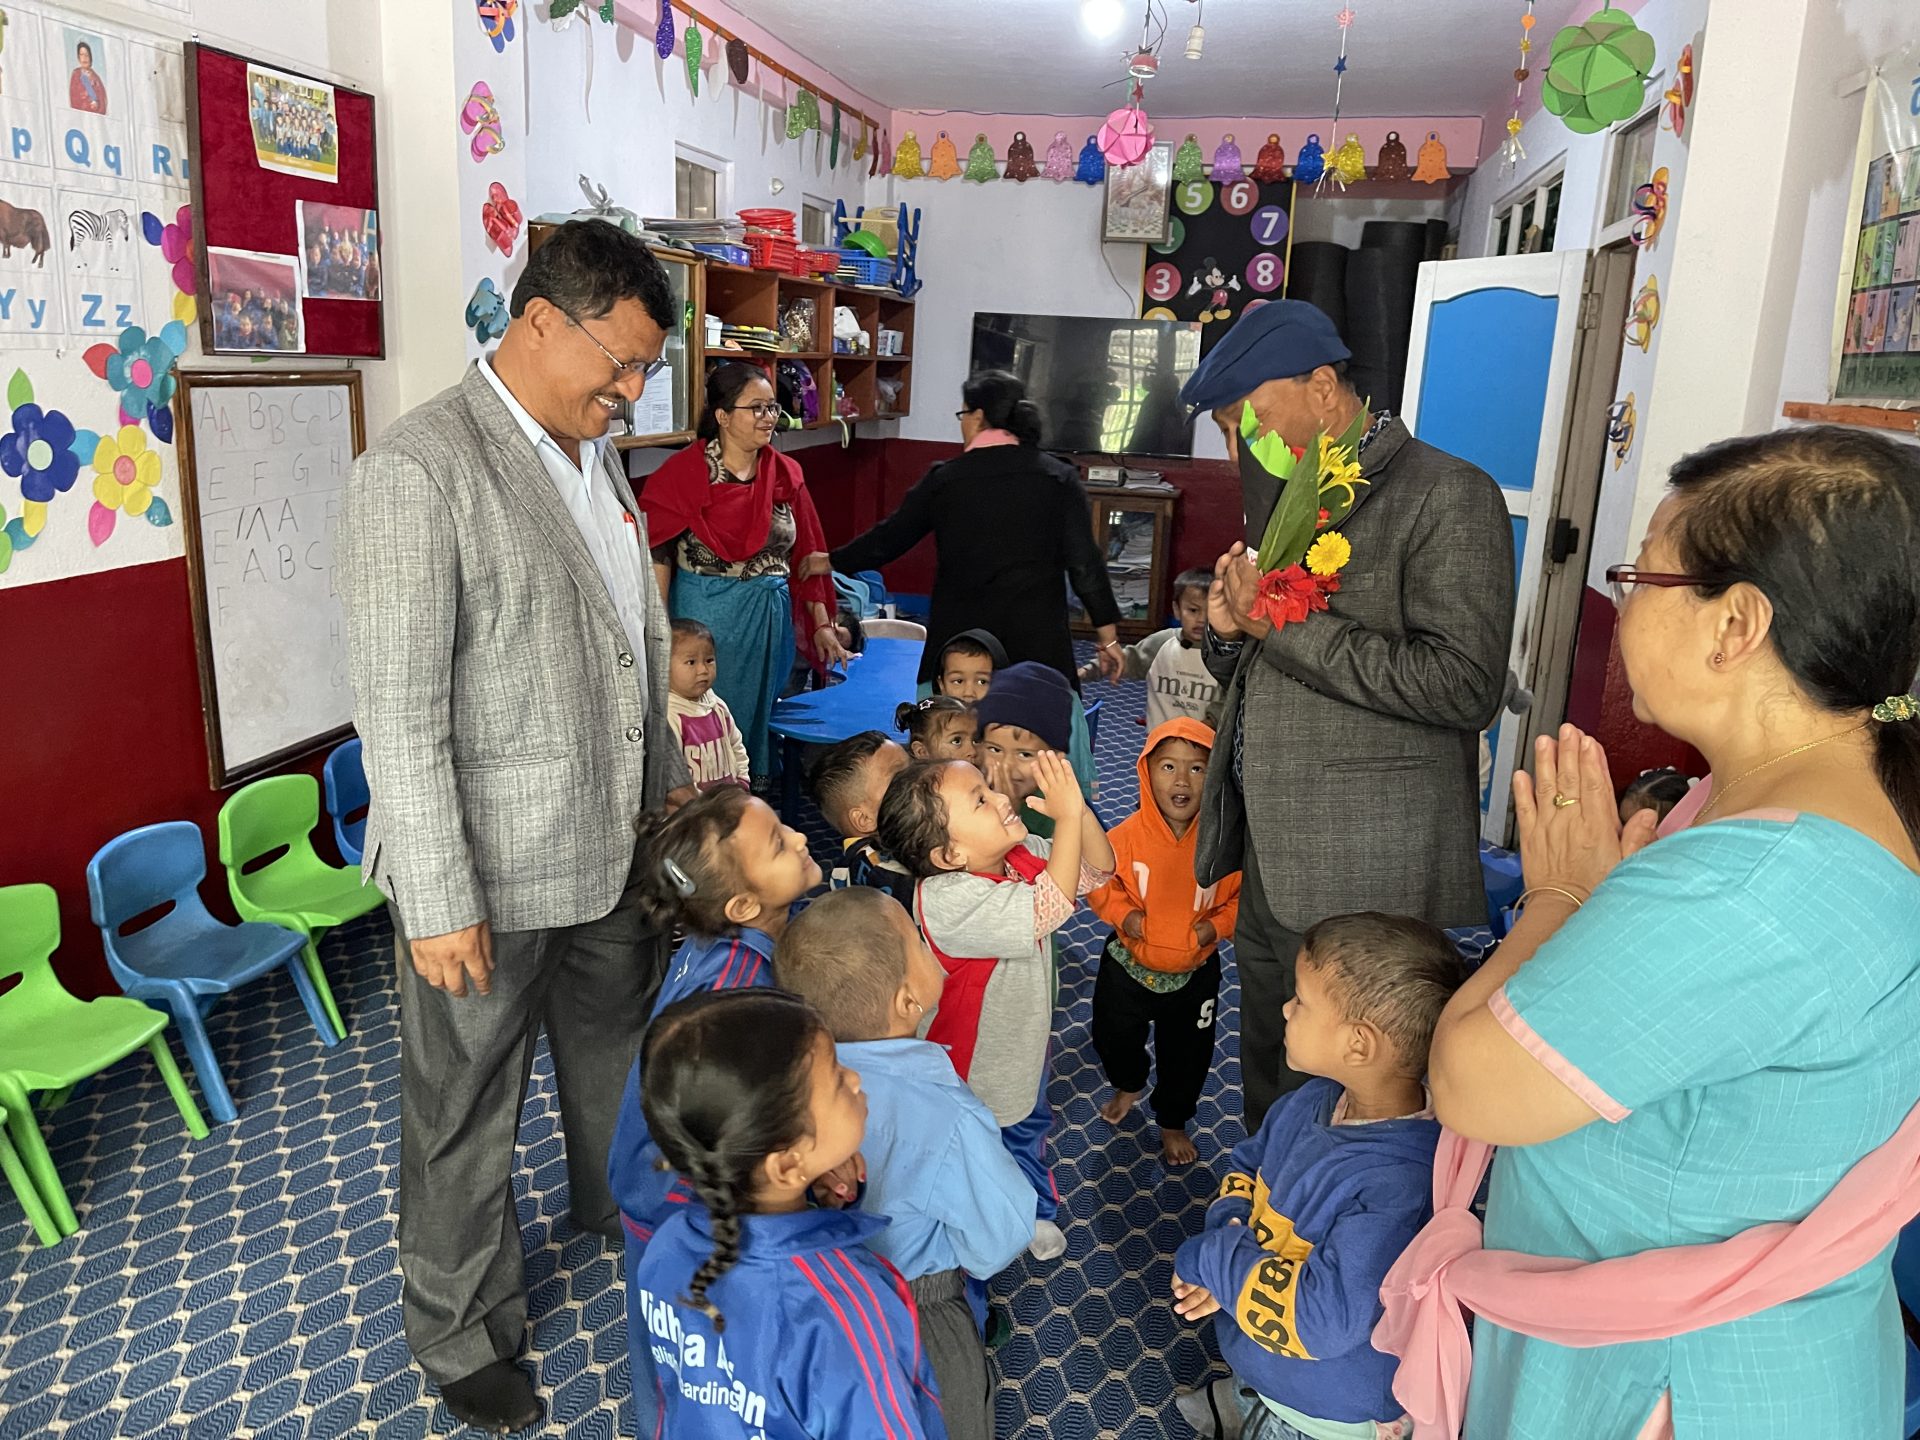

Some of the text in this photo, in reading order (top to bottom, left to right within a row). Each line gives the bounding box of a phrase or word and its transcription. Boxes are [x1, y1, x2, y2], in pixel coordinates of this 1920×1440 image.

[65, 129, 91, 167] Q
[104, 144, 122, 176] q
[152, 144, 173, 177] R
[1185, 183, 1250, 209] 5 6
[1261, 212, 1280, 238] 7
[1153, 260, 1275, 295] 3 8
[81, 294, 106, 327] Z
[199, 390, 344, 431] A B C D
[220, 404, 322, 446] A B C
[208, 446, 341, 501] E F G H
[278, 497, 300, 533] A
[214, 529, 230, 565] E
[243, 541, 325, 583] A B C
[1197, 998, 1215, 1029] S
